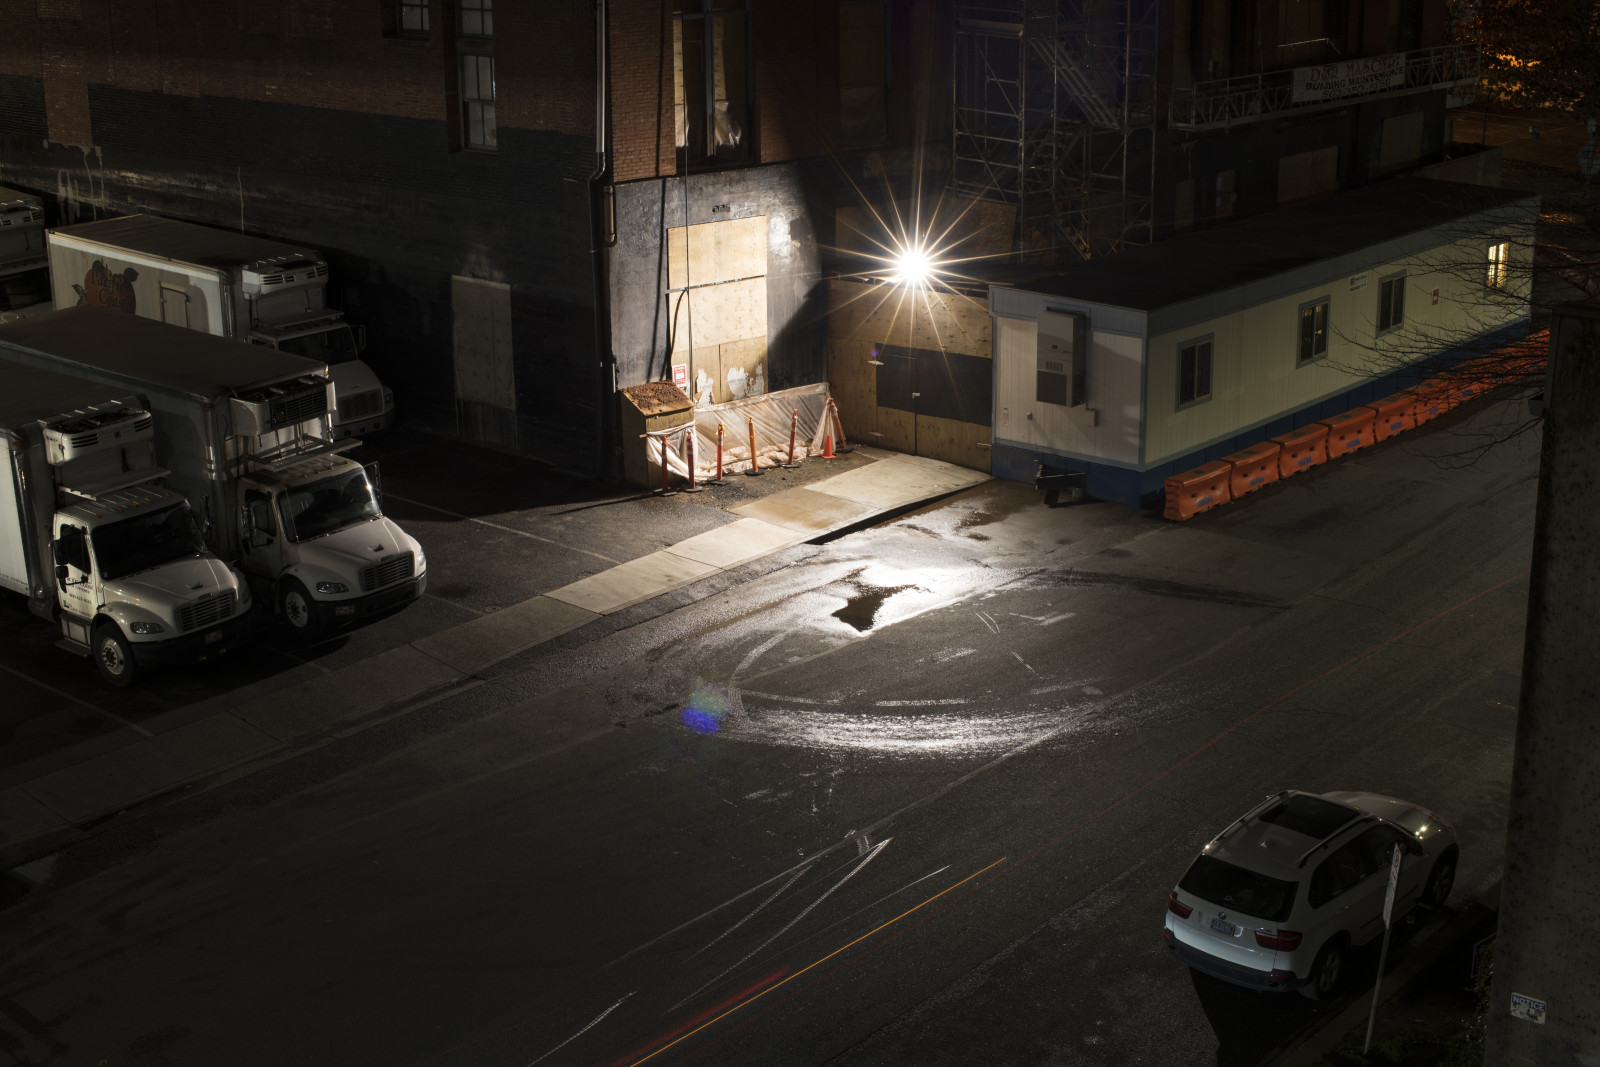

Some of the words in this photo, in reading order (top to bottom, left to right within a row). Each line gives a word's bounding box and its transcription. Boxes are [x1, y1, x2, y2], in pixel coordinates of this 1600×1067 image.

[1346, 54, 1401, 75] MASONRY
[1306, 79, 1345, 91] BUILDING
[1513, 995, 1545, 1012] NOTICE
